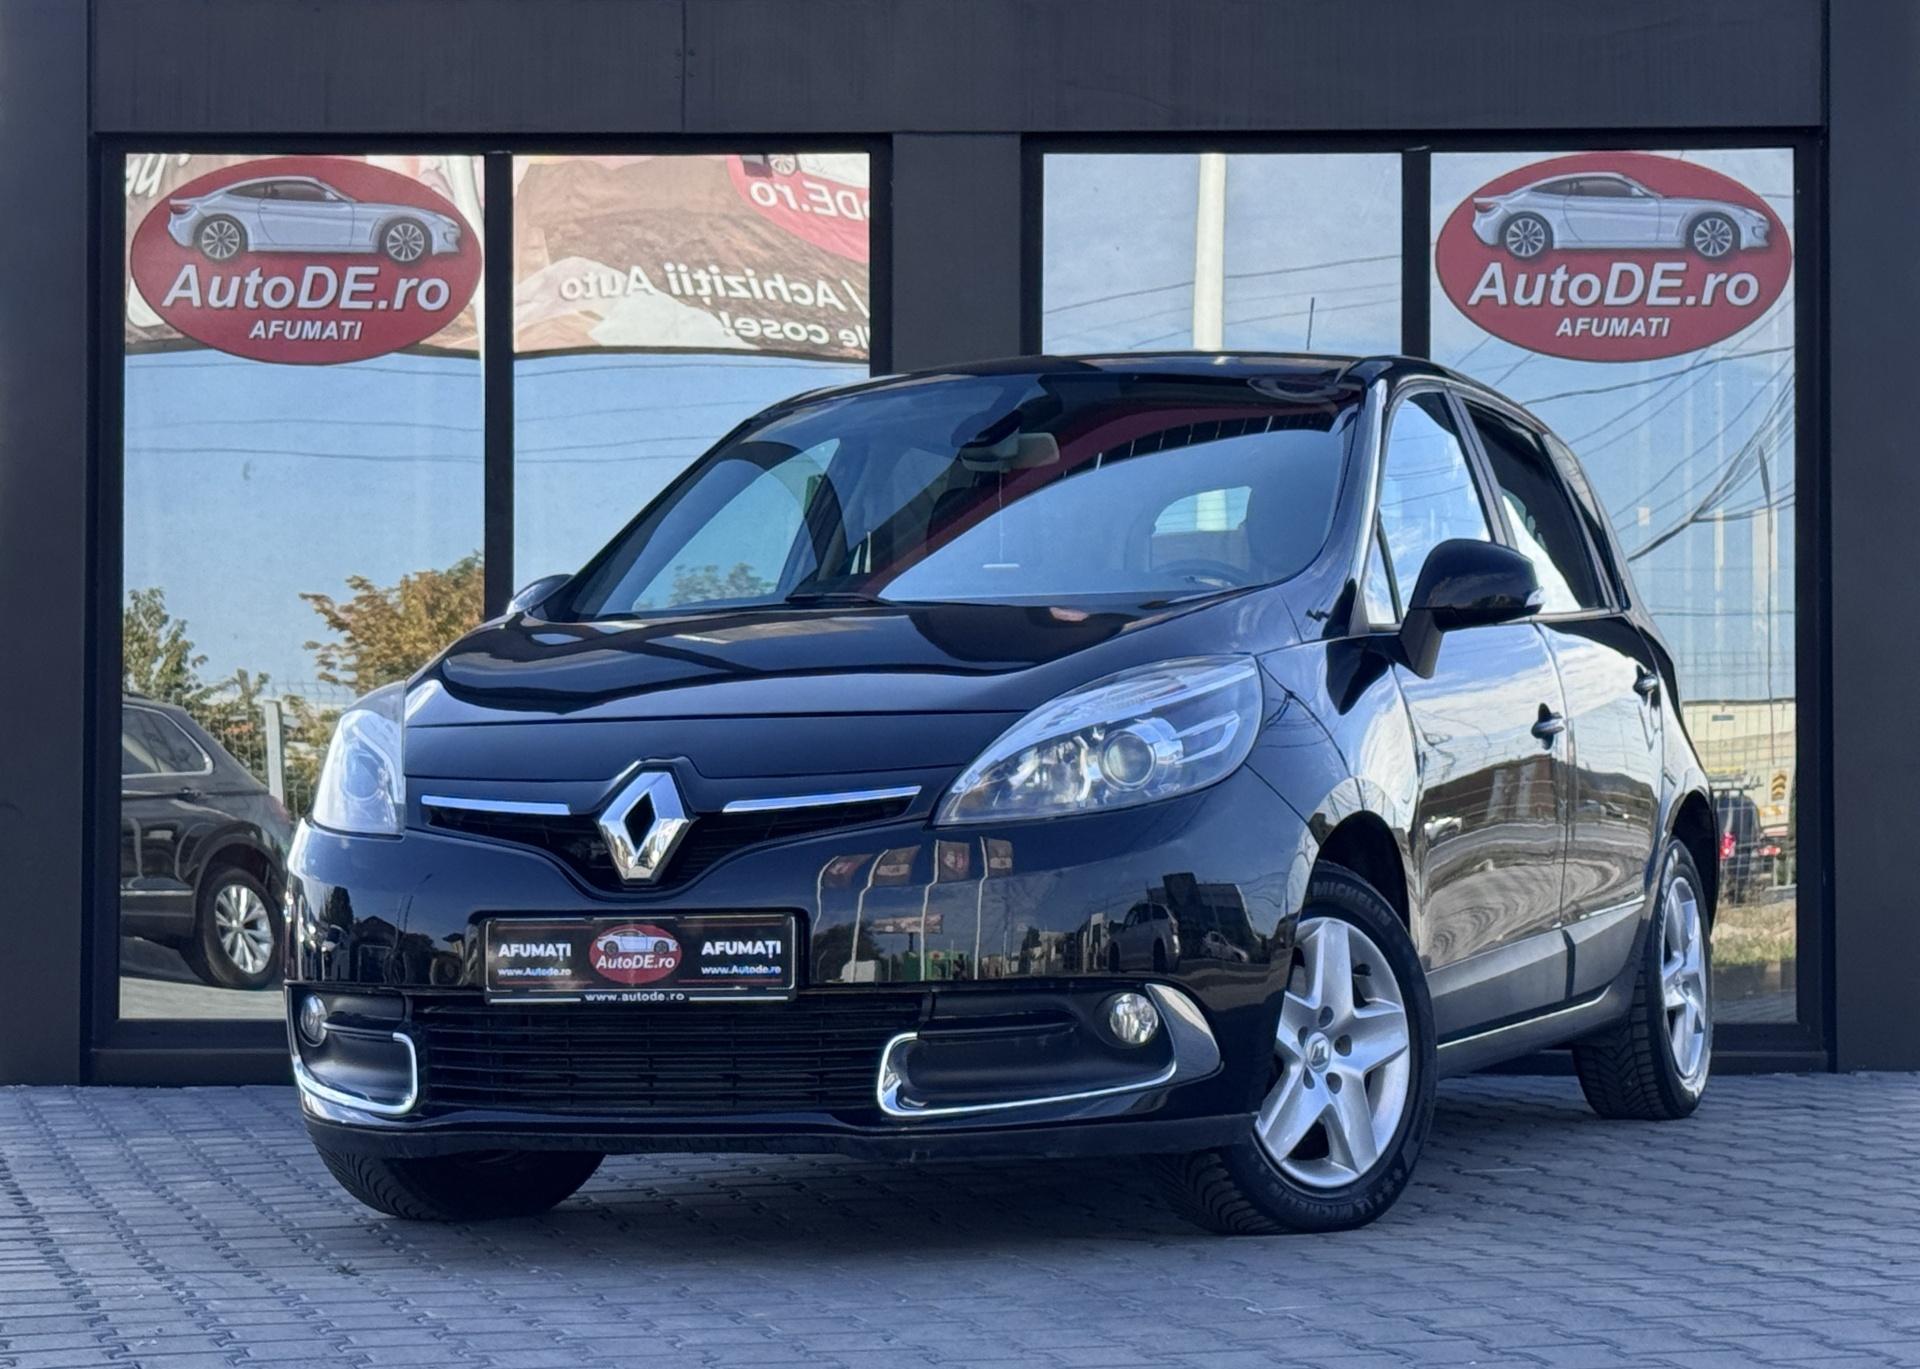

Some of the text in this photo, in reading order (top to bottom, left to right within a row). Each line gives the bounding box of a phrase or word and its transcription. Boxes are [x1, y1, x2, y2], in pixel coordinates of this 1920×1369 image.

[162, 264, 450, 311] AutoDE.ro
[1467, 262, 1760, 307] AutoDE.ro
[249, 320, 363, 340] AFUMATI
[1556, 318, 1671, 337] AFUMATI
[596, 954, 675, 969] AutoDE.ro
[497, 966, 572, 977] www.Autode.ro
[585, 991, 685, 1002] www.autode.ro
